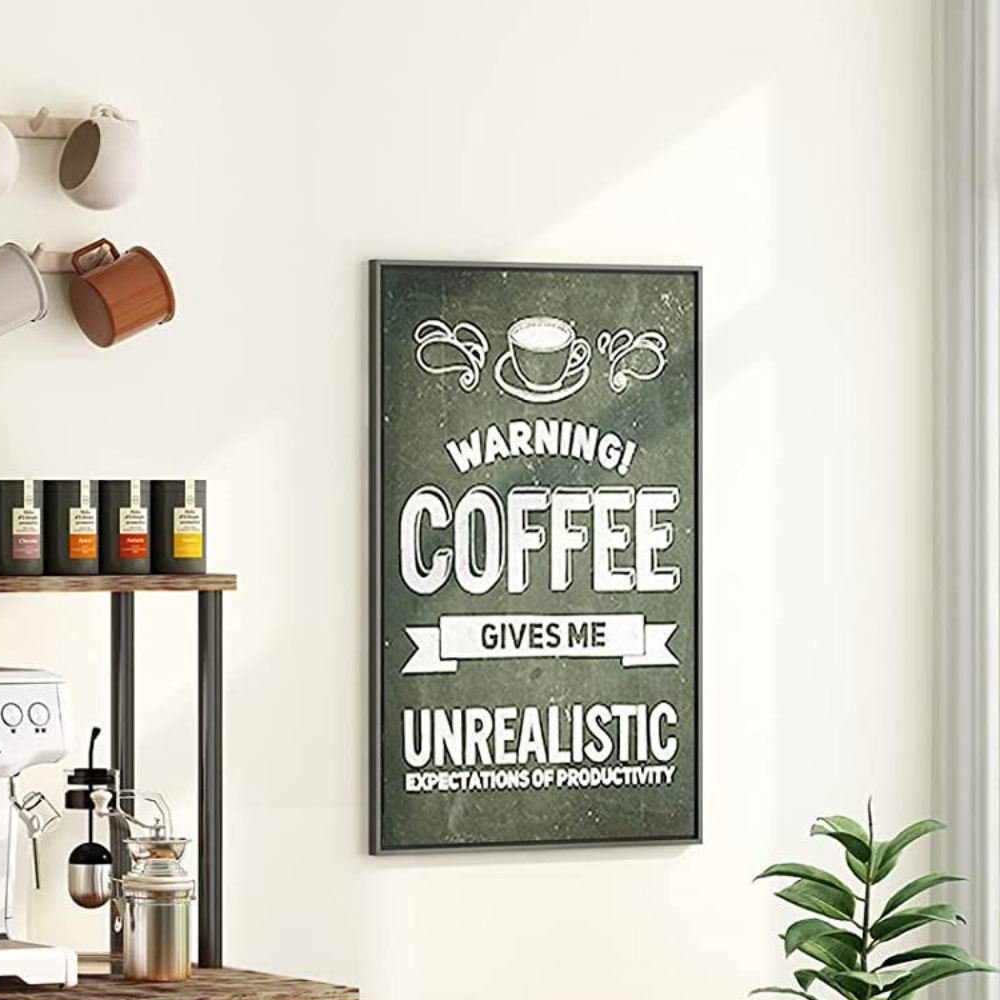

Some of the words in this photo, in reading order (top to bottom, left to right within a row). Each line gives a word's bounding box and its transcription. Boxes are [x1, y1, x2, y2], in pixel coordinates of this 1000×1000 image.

[445, 418, 637, 475] WARNING!
[399, 484, 681, 595] COFFEE
[481, 622, 561, 650] GIVES
[567, 621, 607, 648] ME
[402, 701, 680, 768] UNREALISTIC
[404, 769, 530, 792] EXPECTATIONS
[531, 769, 553, 789] OF
[556, 765, 676, 789] PRODUCTIVITY
